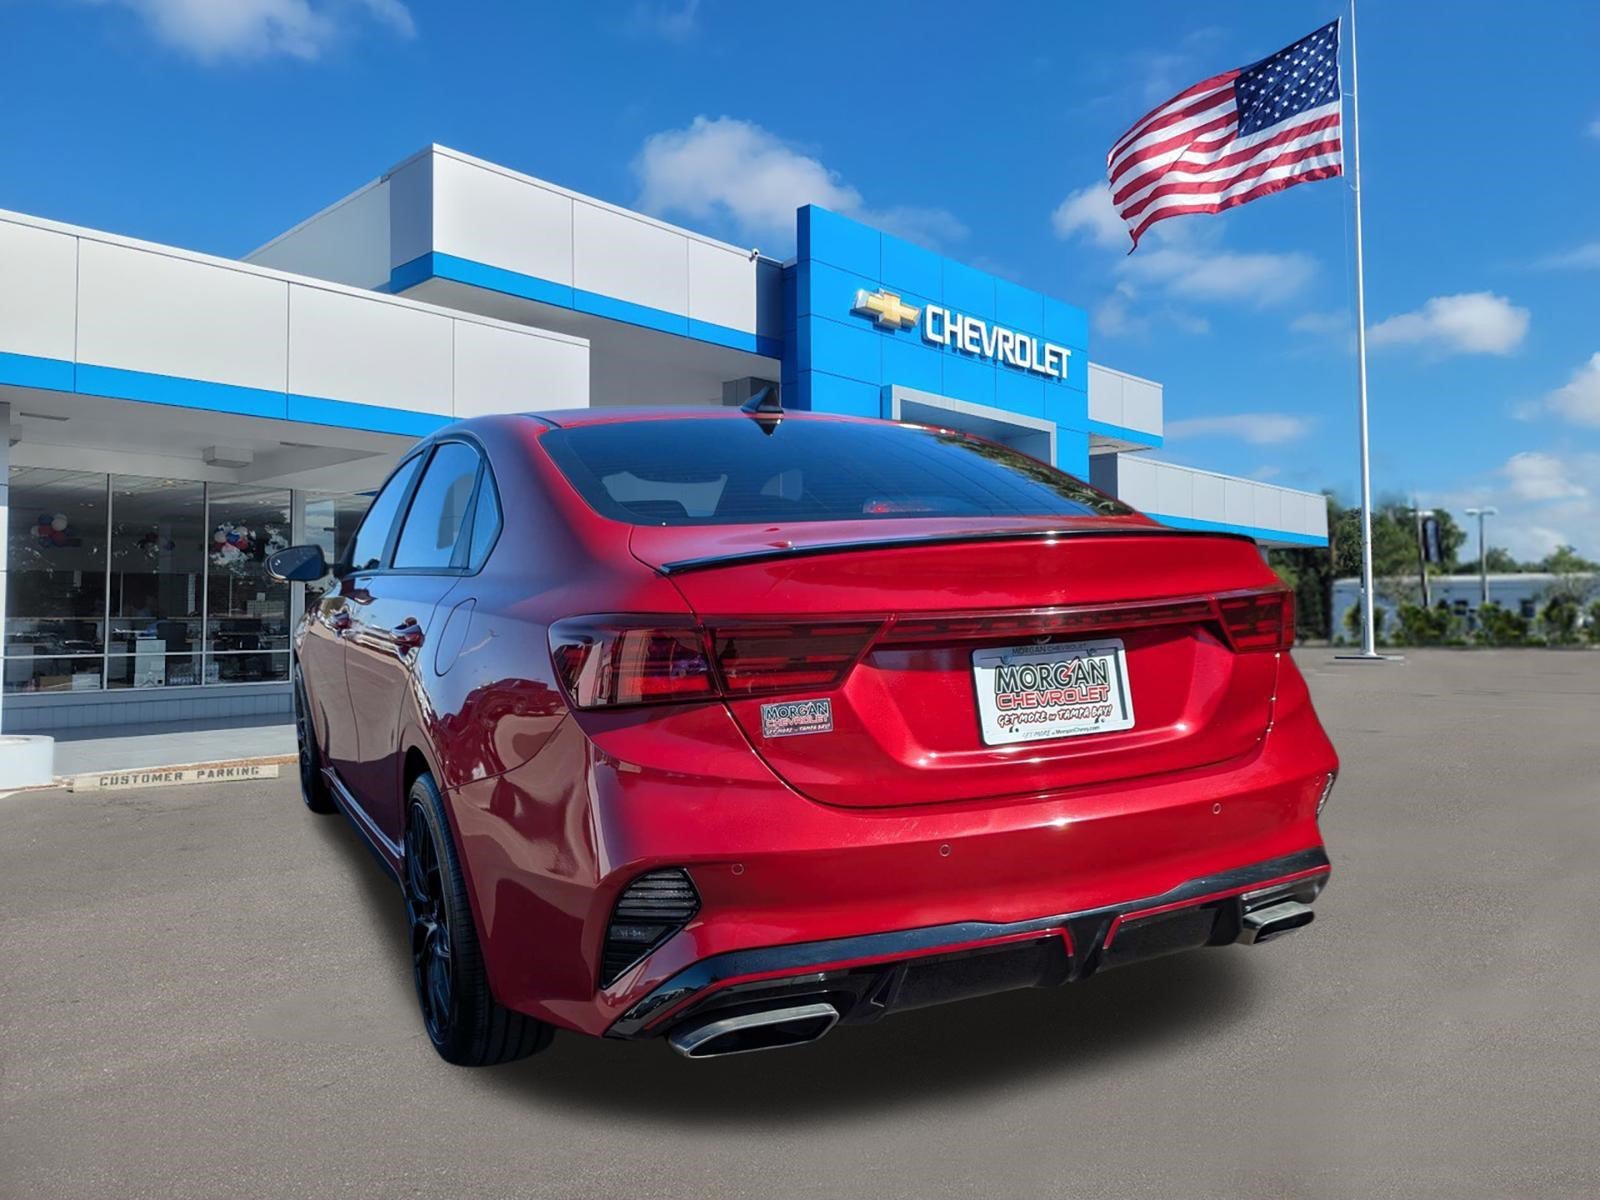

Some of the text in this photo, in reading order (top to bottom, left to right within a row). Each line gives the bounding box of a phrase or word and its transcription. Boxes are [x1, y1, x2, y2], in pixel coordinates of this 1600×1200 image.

[925, 304, 1072, 379] CHEVROLET
[995, 657, 1110, 694] MORGAN
[996, 685, 1110, 711] CHEVROLET
[764, 702, 829, 720] MORGAN
[998, 714, 1017, 728] GET
[1018, 710, 1047, 724] MORE
[1057, 707, 1090, 720] TAMPA
[1091, 704, 1113, 718] BAY!
[99, 766, 259, 786] CUSTOMER PARKING
